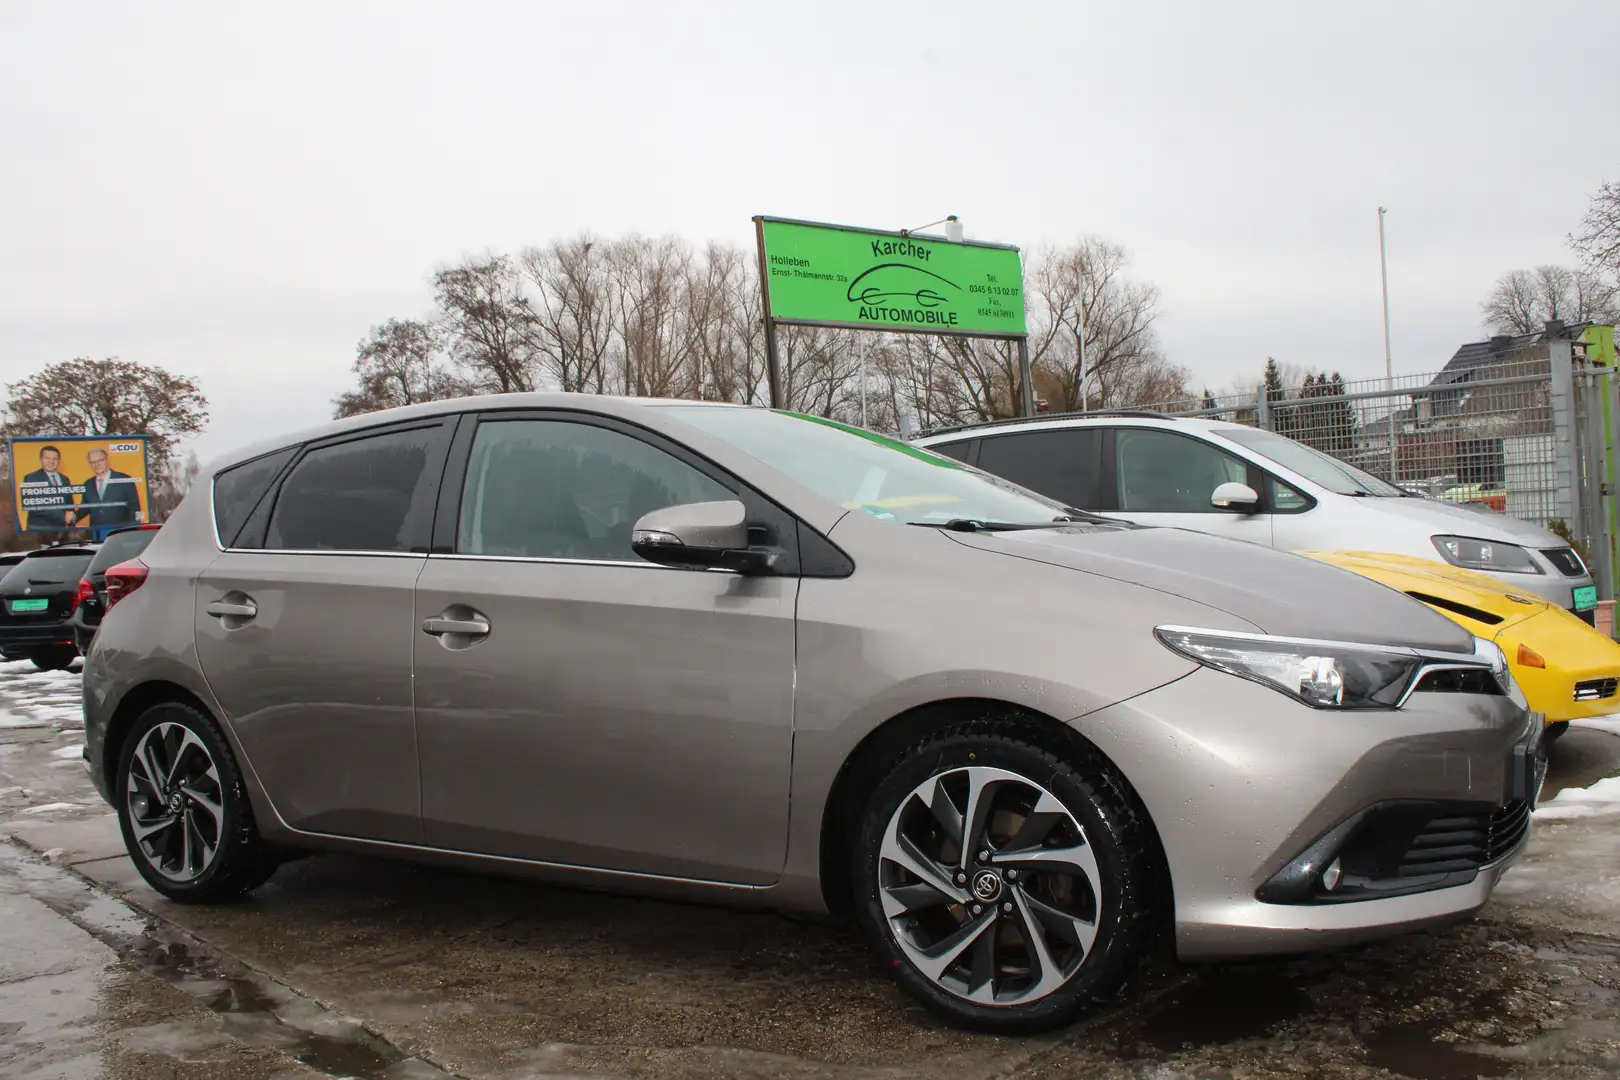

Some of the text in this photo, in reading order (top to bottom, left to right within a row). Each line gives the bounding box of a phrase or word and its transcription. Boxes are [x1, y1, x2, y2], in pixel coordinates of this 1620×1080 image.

[871, 239, 932, 262] Karcher
[771, 254, 810, 267] Holleben
[772, 267, 793, 277] Ernst-
[837, 274, 848, 282] 32a
[969, 284, 1019, 297] 0345 6 13 02 07
[858, 305, 958, 325] AUTOMOBILE
[977, 307, 992, 317] 0345
[116, 444, 138, 452] CDU
[22, 485, 86, 496] FROHES NEUES
[23, 496, 65, 506] GESICHT!
